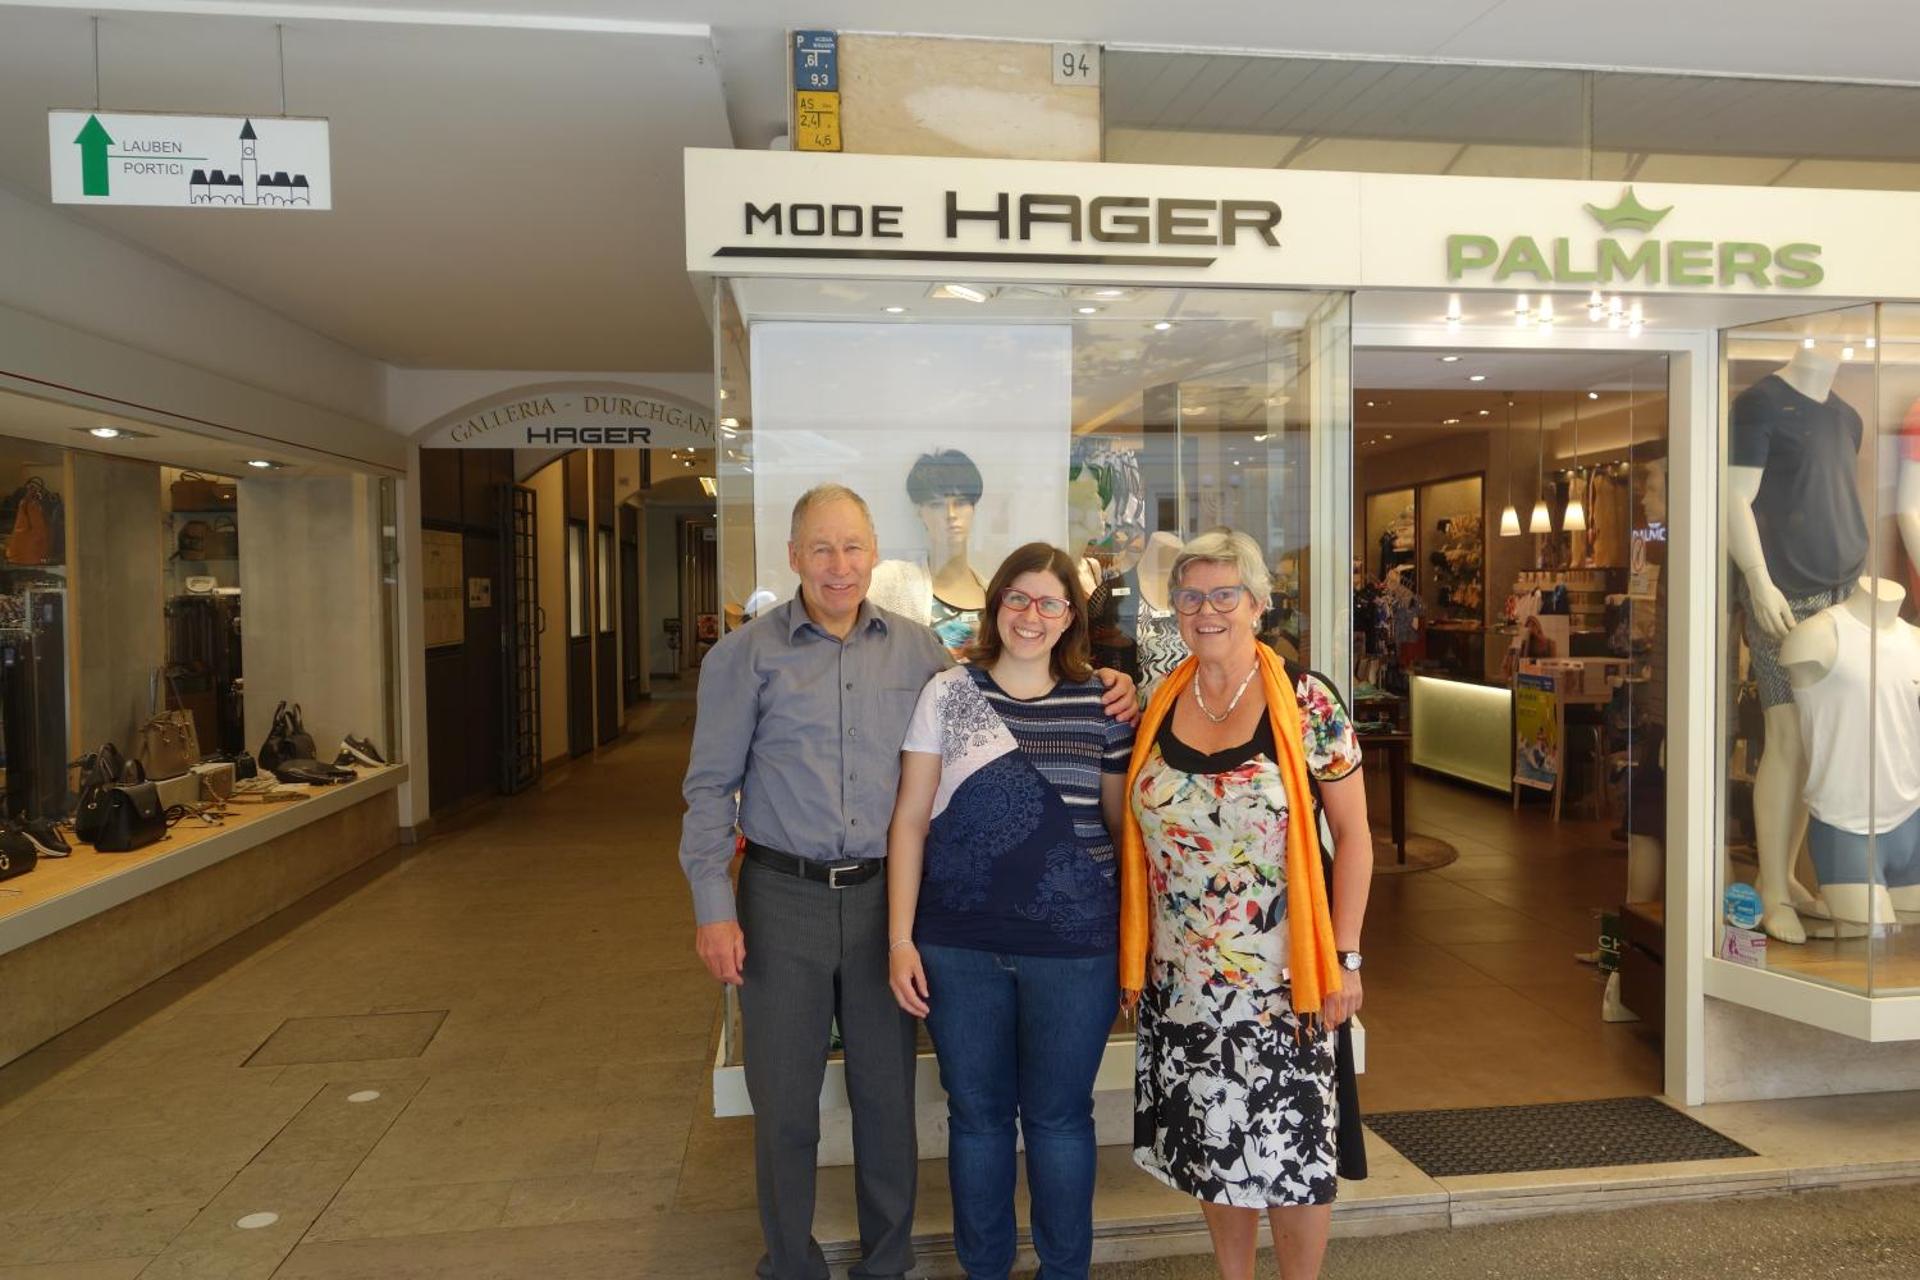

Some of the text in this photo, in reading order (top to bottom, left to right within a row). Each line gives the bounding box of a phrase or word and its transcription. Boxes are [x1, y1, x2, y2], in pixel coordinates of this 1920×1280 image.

[796, 35, 805, 48] P
[1062, 52, 1090, 77] 94
[800, 98, 814, 109] AS
[122, 140, 183, 153] LAUBEN
[123, 162, 184, 175] PORTICI
[745, 190, 1282, 247] MODE HAGER
[1446, 233, 1825, 289] PALMERS
[450, 398, 556, 443] GALLERIA
[527, 427, 651, 444] HAGER
